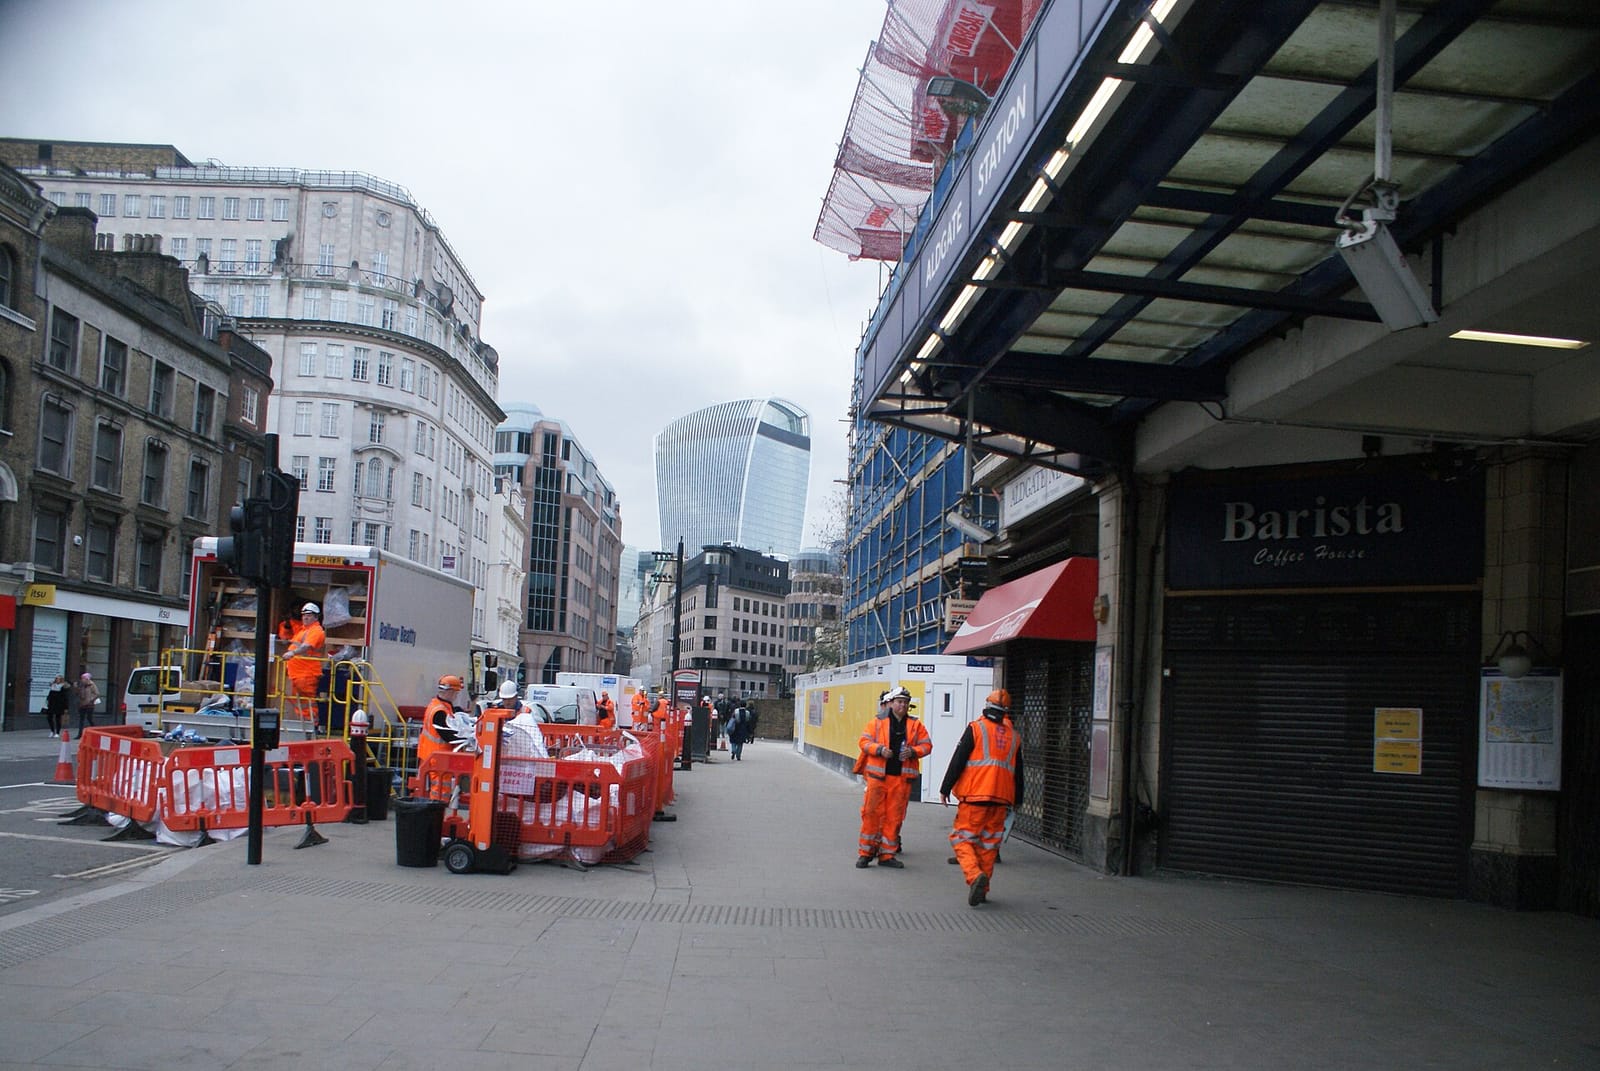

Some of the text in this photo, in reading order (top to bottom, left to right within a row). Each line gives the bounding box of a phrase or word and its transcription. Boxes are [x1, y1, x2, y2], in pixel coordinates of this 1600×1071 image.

[926, 83, 1026, 288] ALDGATE STATION
[1220, 495, 1406, 542] Barista
[1253, 544, 1366, 567] Coffee House
[31, 589, 47, 598] itsu
